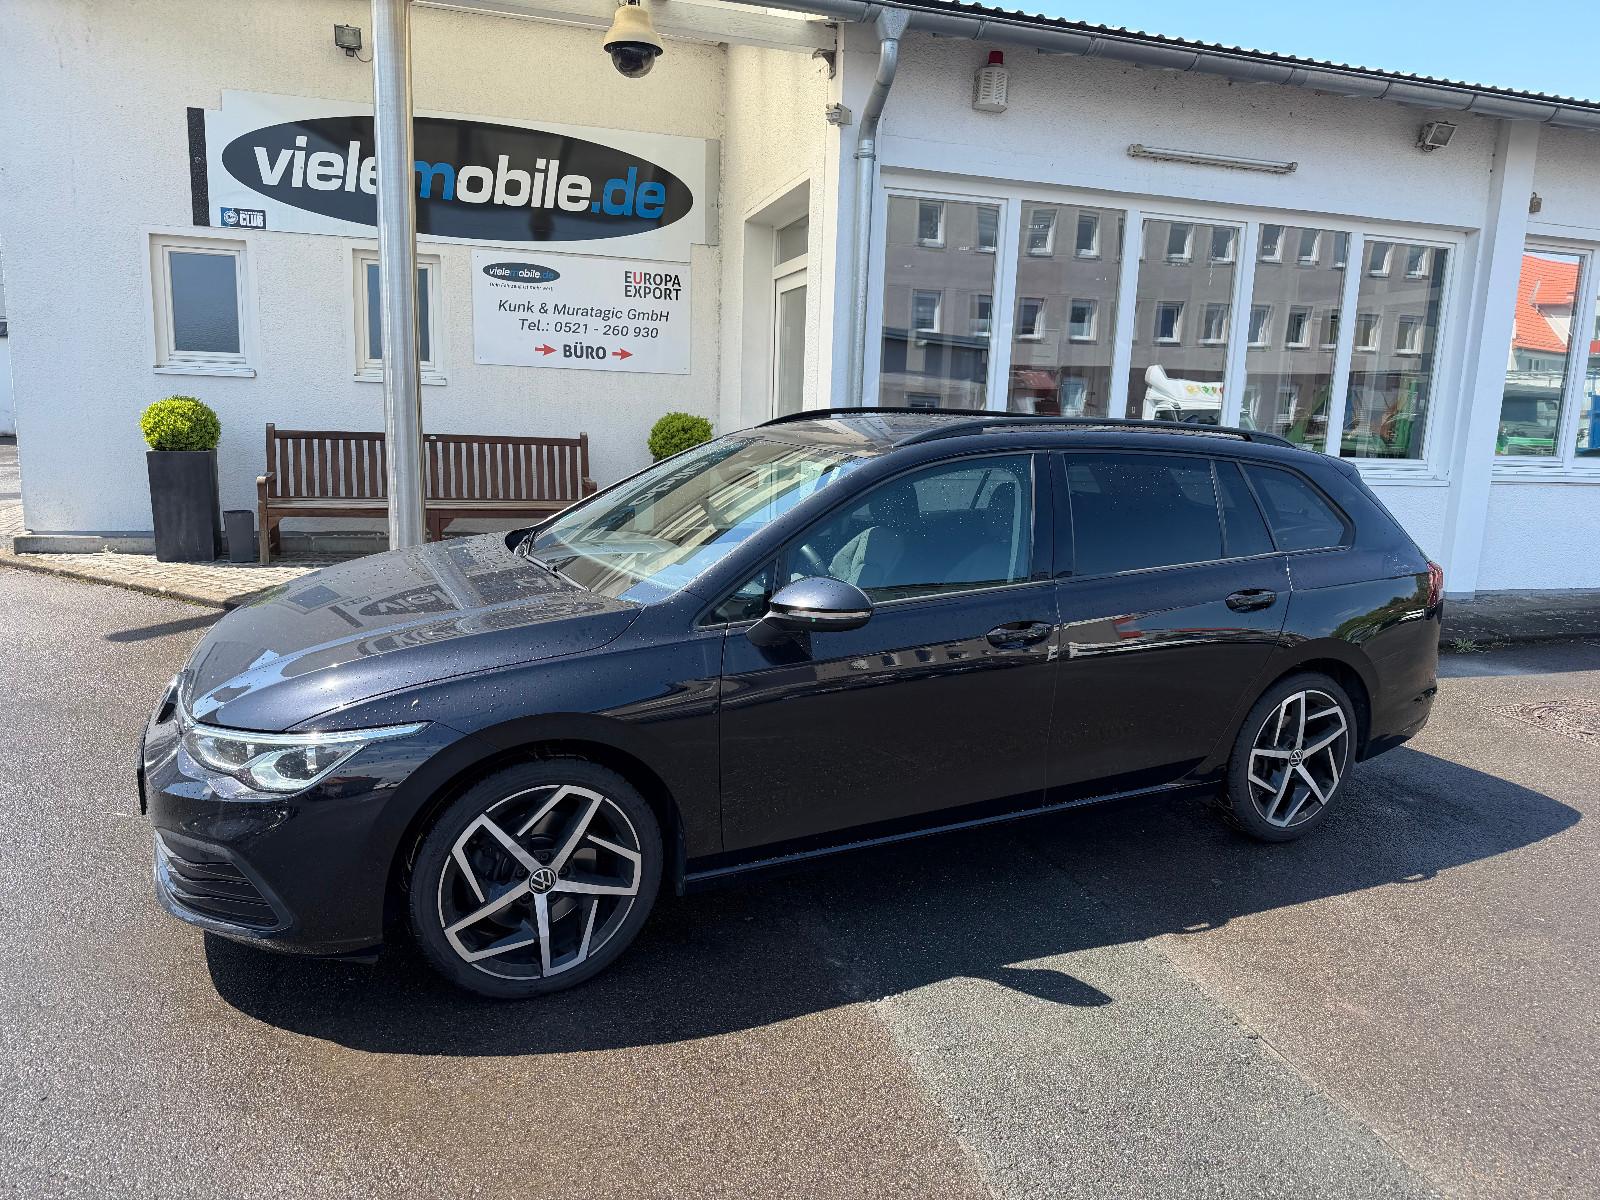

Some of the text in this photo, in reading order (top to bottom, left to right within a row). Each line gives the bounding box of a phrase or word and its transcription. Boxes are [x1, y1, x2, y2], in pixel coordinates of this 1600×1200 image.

[240, 213, 264, 227] CLUB
[624, 270, 681, 288] EUROPA
[624, 285, 681, 300] EXPORT
[498, 299, 670, 322] Kunk & Muratagic GmbH
[518, 318, 549, 332] Tel.:
[554, 321, 588, 334] 0521
[603, 324, 629, 337] 260
[633, 326, 659, 339] 930
[562, 342, 607, 360] BÜRO
